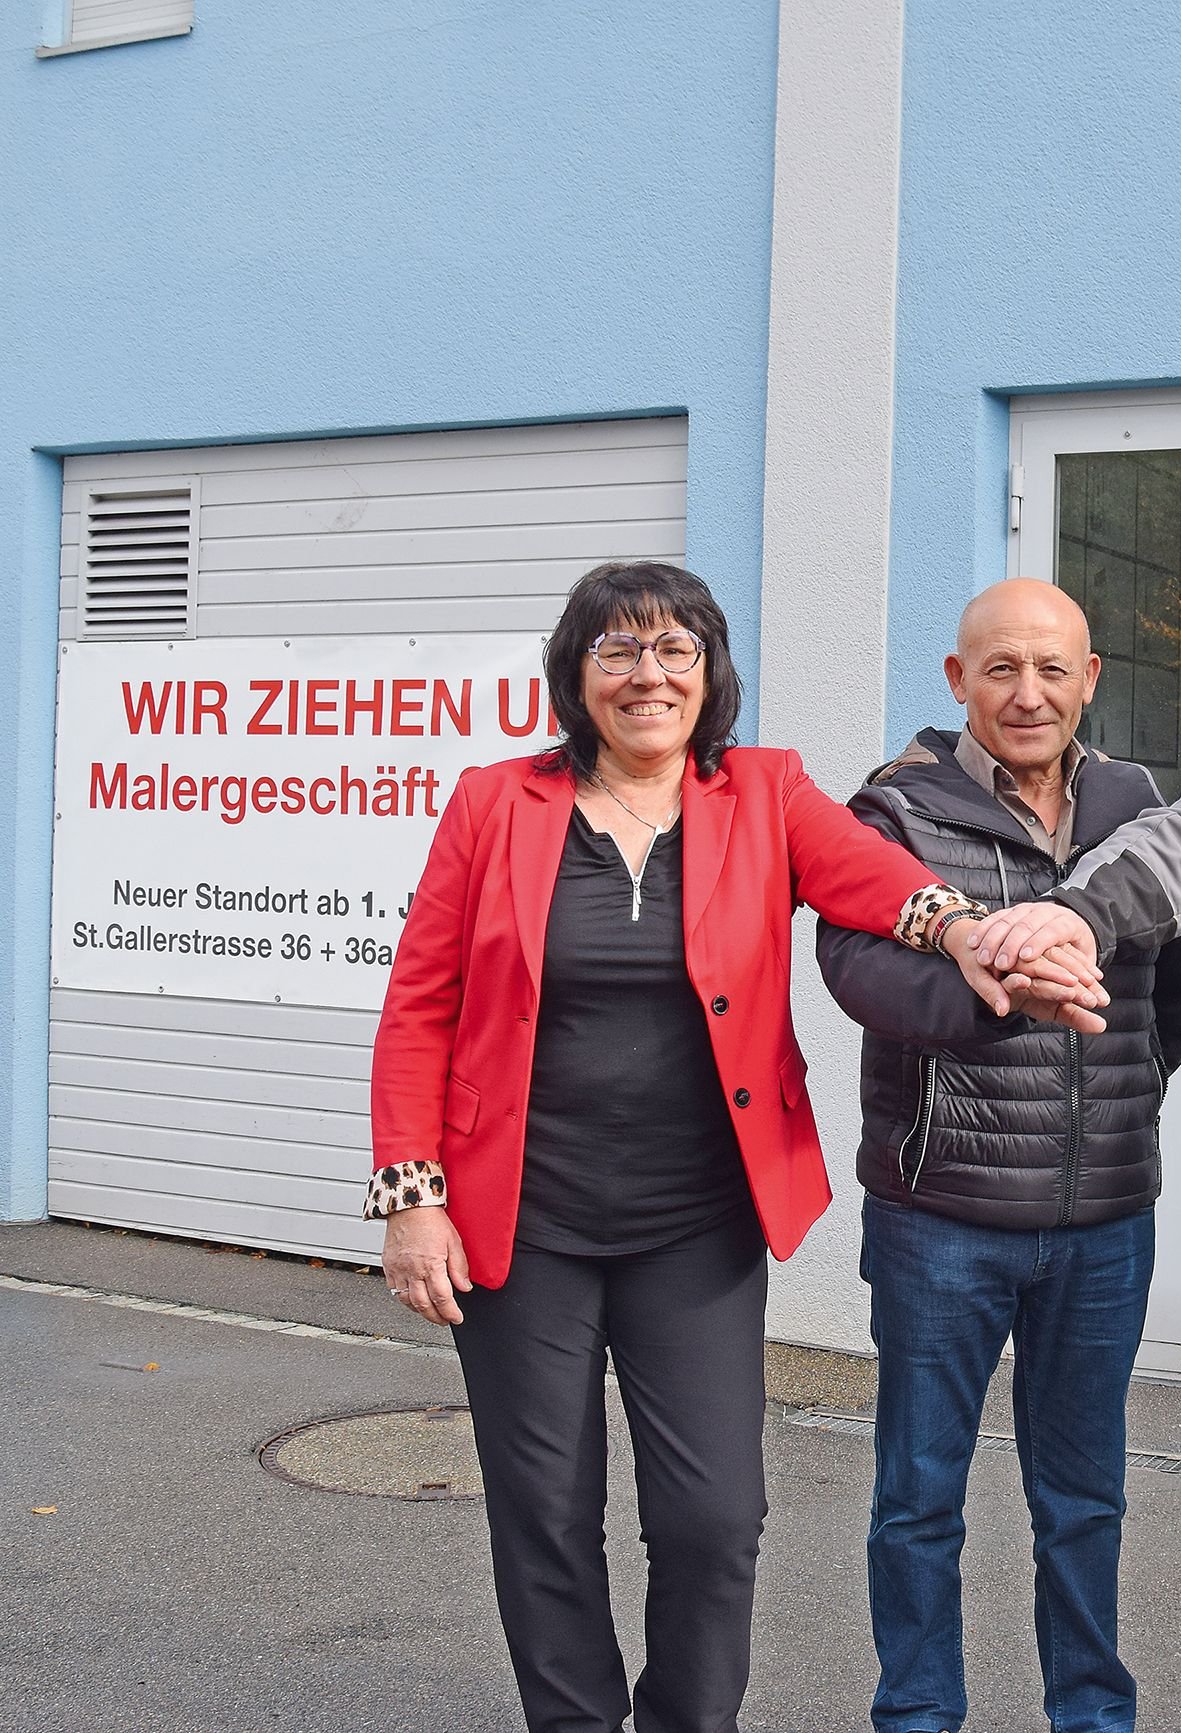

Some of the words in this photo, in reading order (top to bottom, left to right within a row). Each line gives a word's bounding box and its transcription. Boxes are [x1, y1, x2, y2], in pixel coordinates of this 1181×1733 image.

[121, 681, 228, 735] WIR
[247, 679, 472, 736] ZIEHEN
[498, 678, 559, 737] U
[89, 763, 440, 824] Malergeschäft
[113, 880, 188, 908] Neuer
[195, 882, 309, 915] Standort
[317, 889, 350, 917] ab
[361, 891, 386, 918] 1.
[72, 921, 272, 959] St.Gallerstrasse
[280, 933, 311, 961] 36
[320, 943, 336, 962] +
[345, 937, 393, 966] 36a
